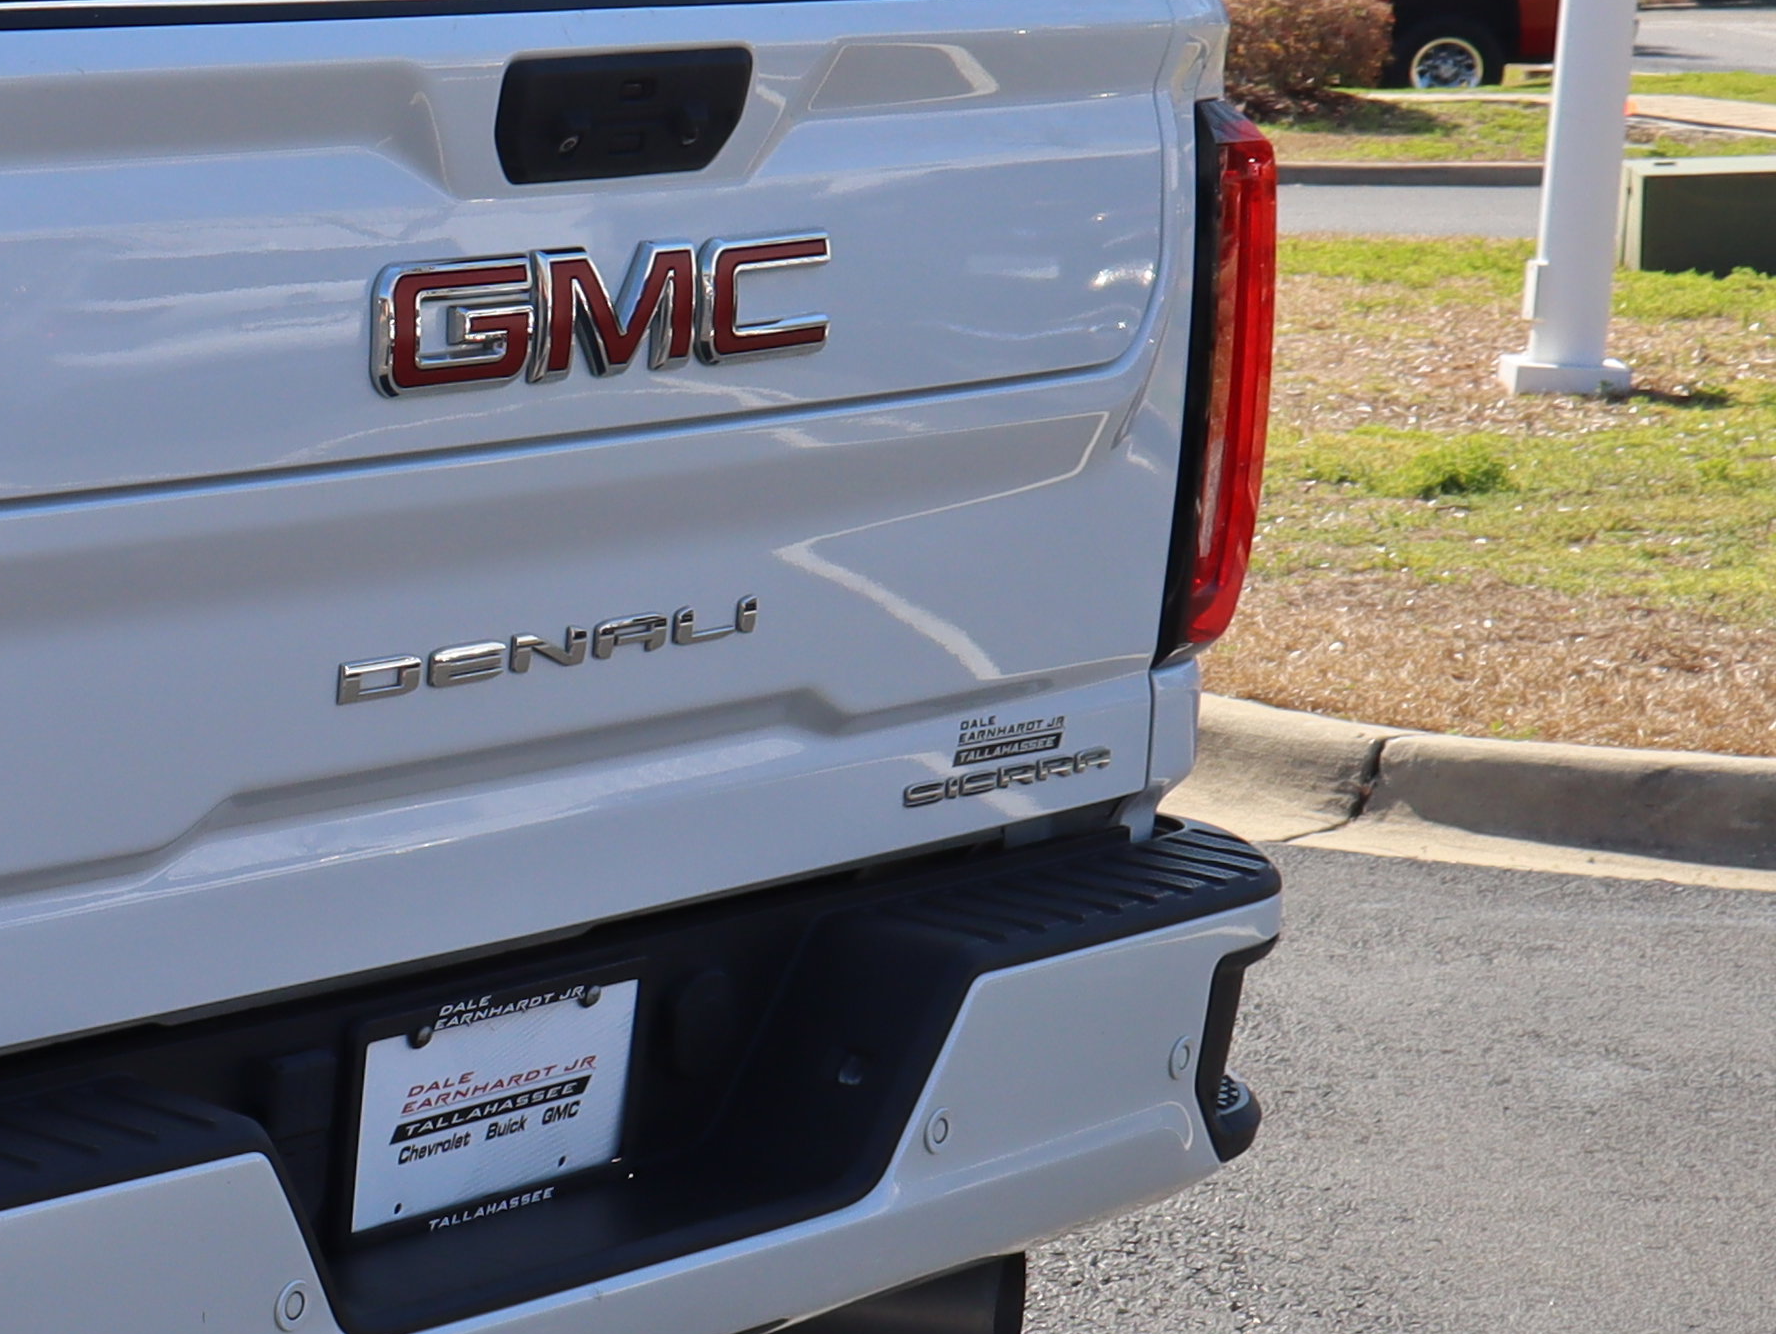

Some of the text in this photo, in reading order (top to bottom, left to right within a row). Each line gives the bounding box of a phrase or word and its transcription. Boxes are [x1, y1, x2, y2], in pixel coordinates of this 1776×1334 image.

[370, 229, 831, 399] GMC
[336, 595, 759, 705] DENALI
[957, 715, 1066, 744] EARNHARDT JR
[959, 715, 997, 731] DALE
[957, 735, 1058, 764] TALLAHASSEE
[903, 745, 1112, 808] SIERRA
[433, 985, 586, 1032] EARNHARDT JR
[438, 994, 493, 1017] DALE
[402, 1054, 598, 1114] EARNHARDT JR
[406, 1070, 476, 1098] DALE
[405, 1082, 578, 1136] TALLAHASSEE
[397, 1101, 580, 1166] Chevrolet Buick GMC
[428, 1186, 555, 1232] TALLAHASSEE
